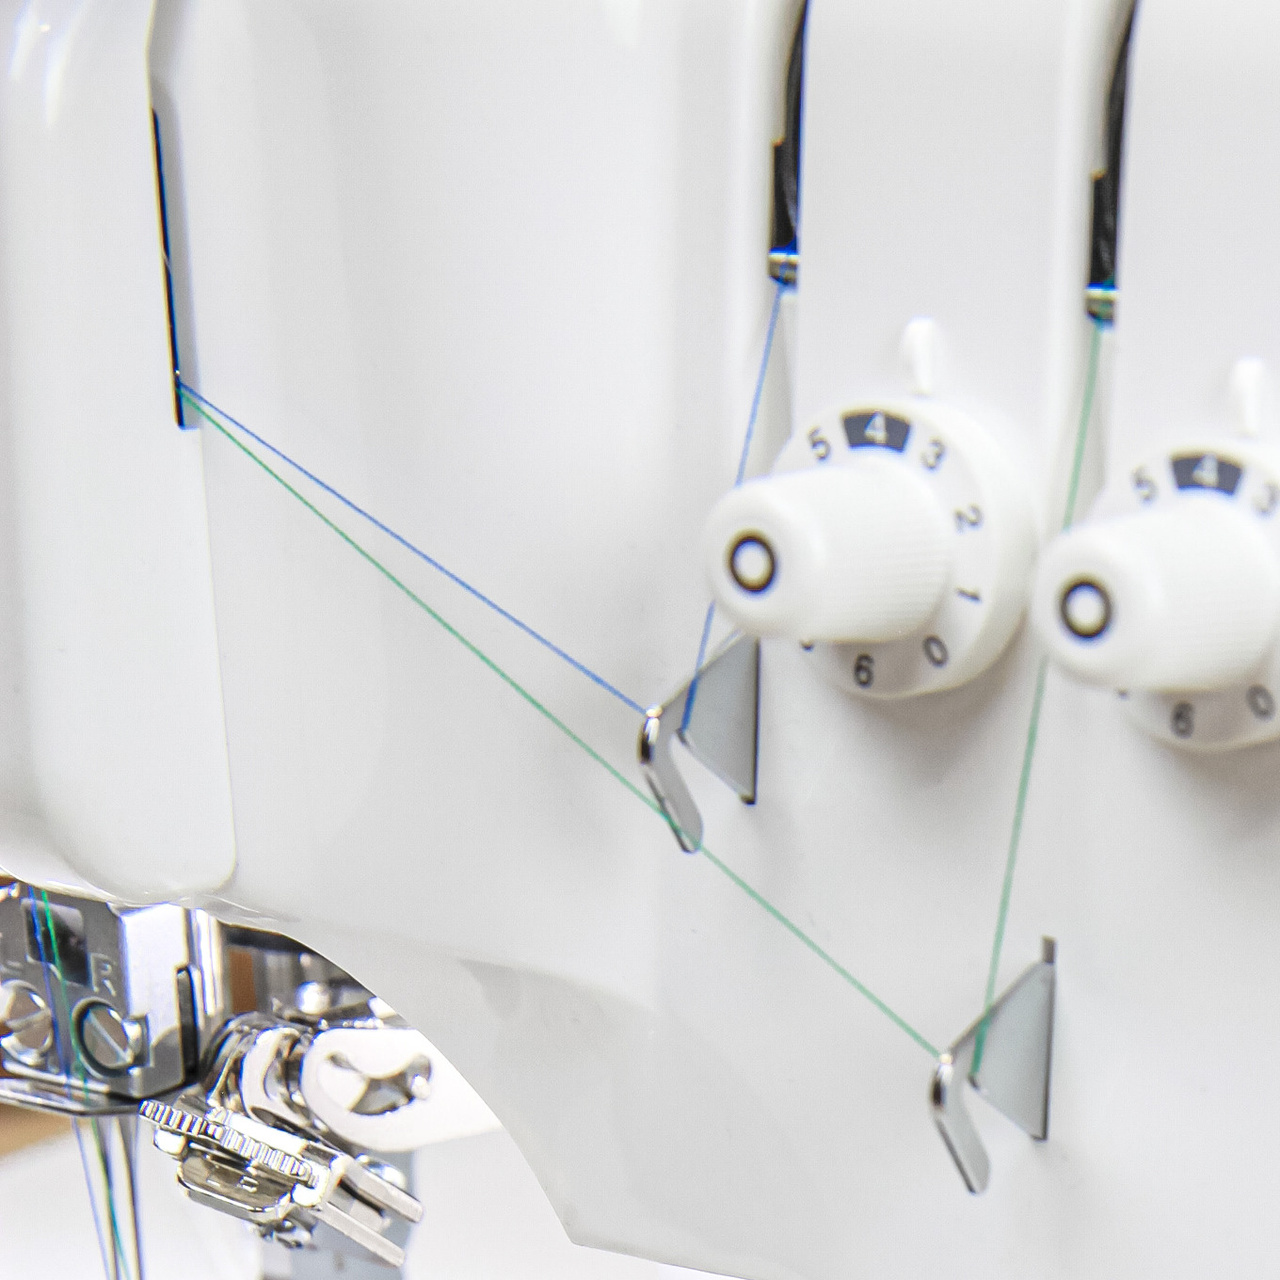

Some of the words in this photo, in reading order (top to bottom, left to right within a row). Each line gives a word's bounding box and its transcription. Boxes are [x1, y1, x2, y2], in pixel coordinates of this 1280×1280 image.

[807, 426, 831, 461] 5
[863, 411, 888, 444] 4
[922, 437, 946, 471] 3
